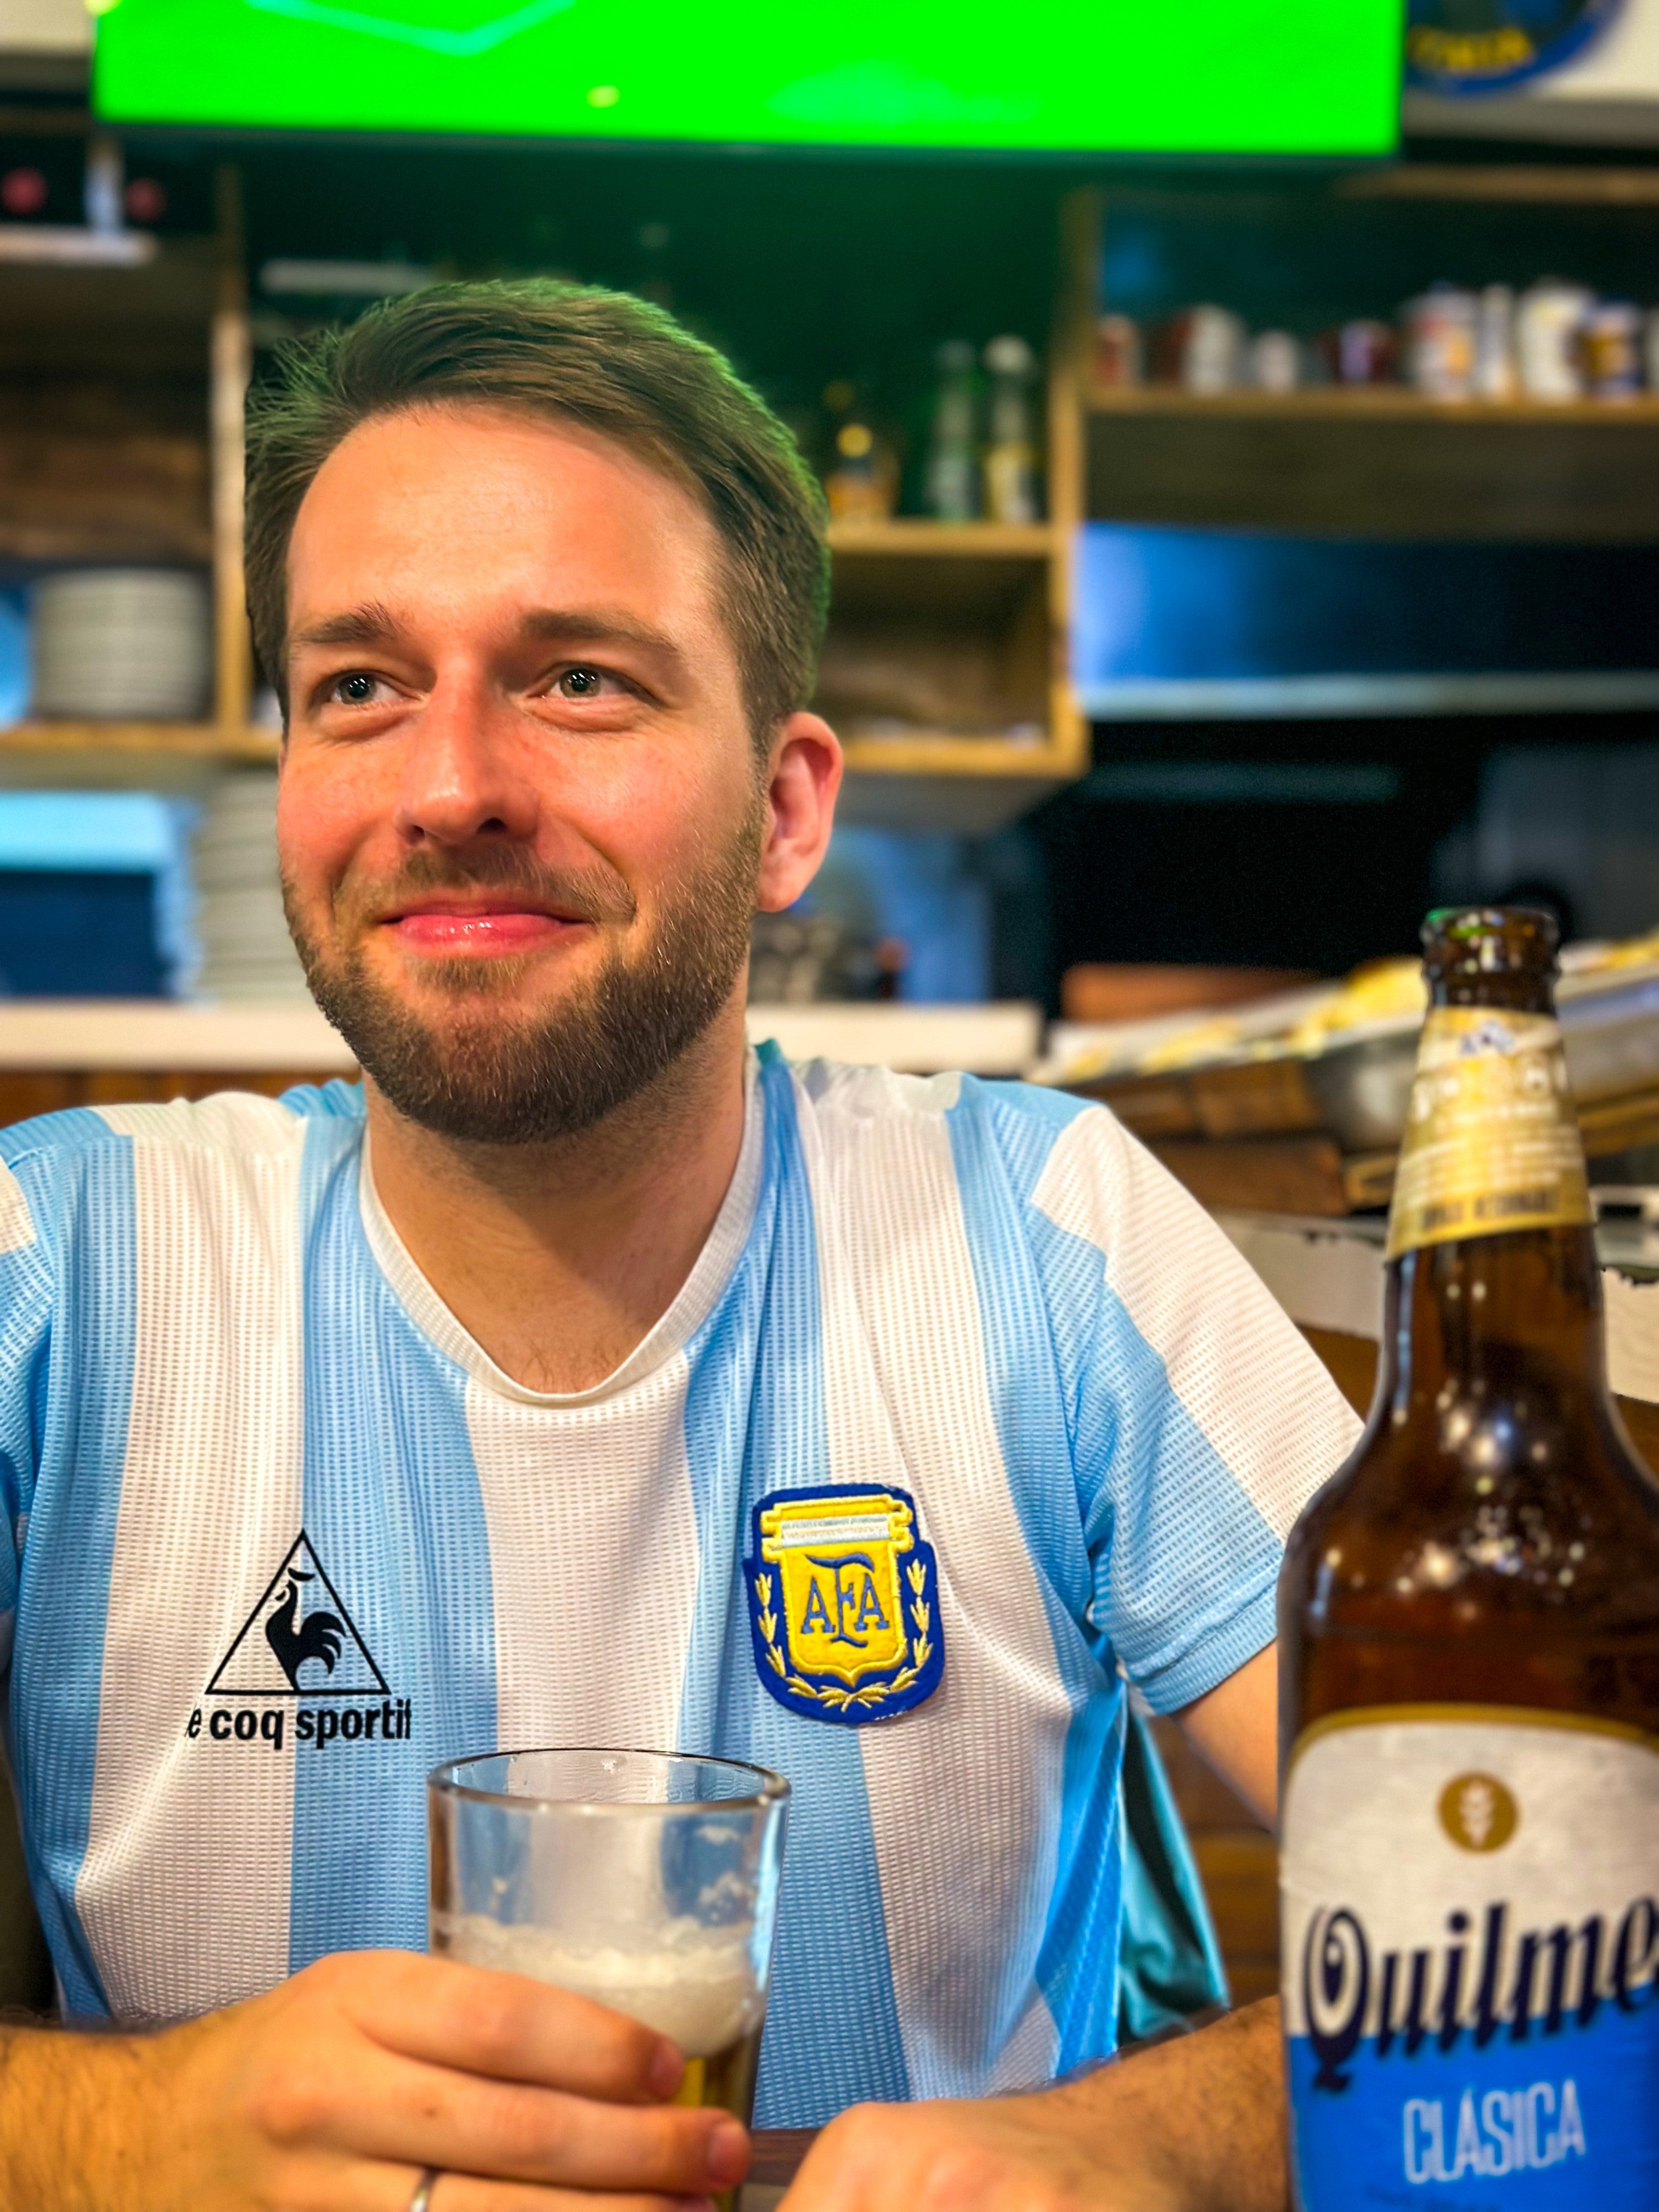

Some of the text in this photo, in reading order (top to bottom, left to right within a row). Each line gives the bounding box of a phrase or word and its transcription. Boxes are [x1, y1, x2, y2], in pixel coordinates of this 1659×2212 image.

[800, 1552, 890, 1649] AFA
[210, 1709, 284, 1750] coq
[1303, 1894, 1659, 2092] Quilme
